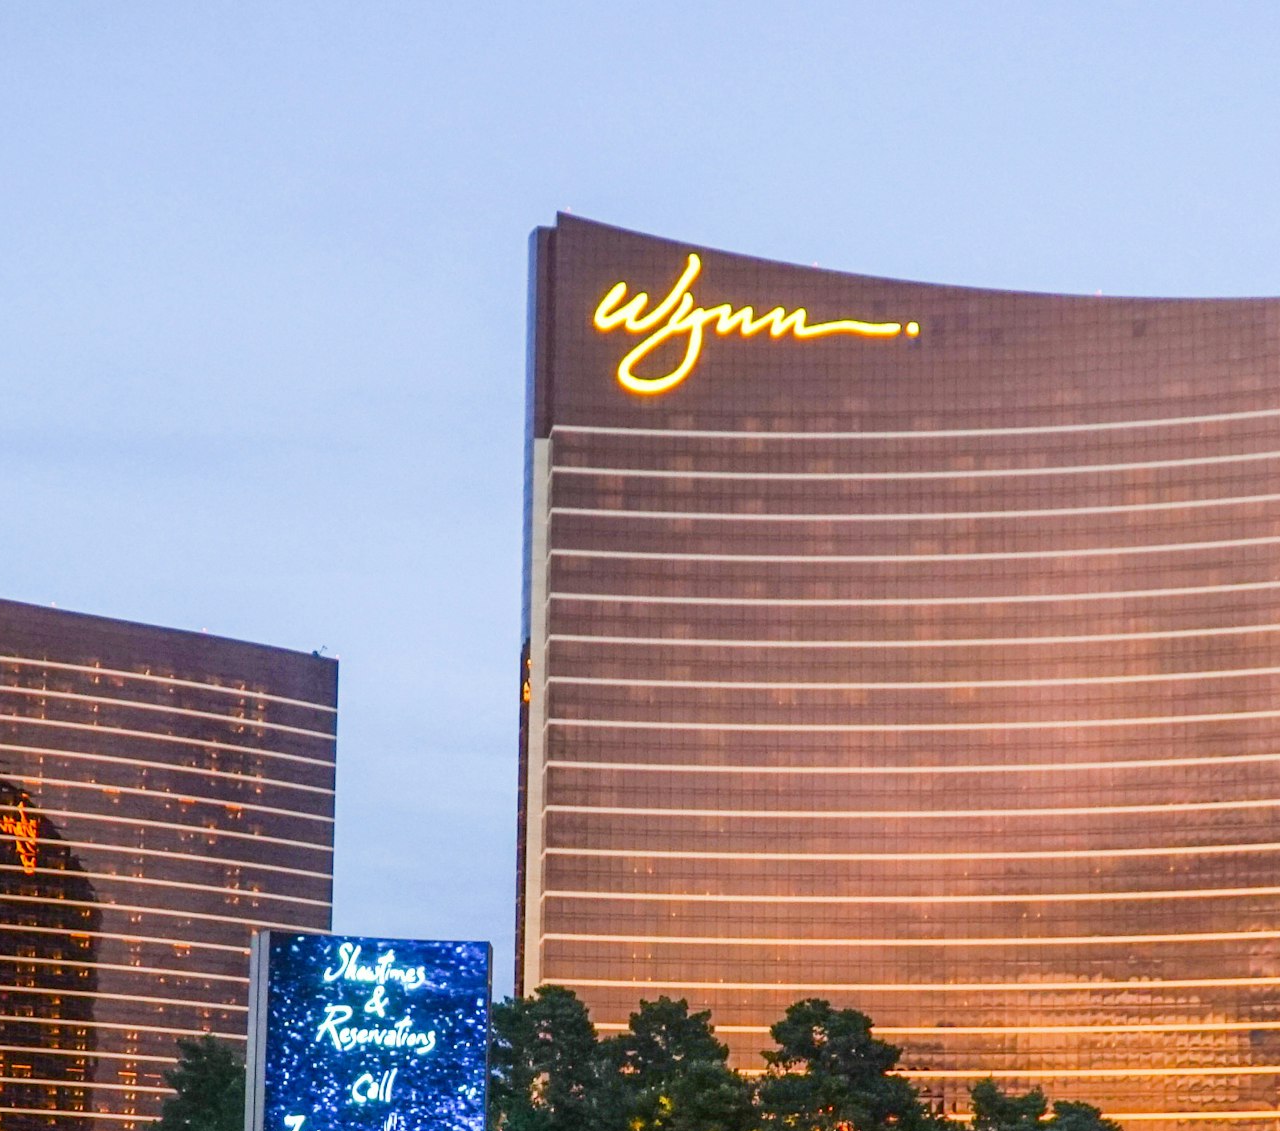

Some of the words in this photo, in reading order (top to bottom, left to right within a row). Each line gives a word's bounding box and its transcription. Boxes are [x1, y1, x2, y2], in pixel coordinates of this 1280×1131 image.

[323, 942, 426, 989] Showtimes
[364, 985, 390, 1017] &
[315, 1005, 436, 1053] Reservations
[352, 1068, 398, 1104] Call
